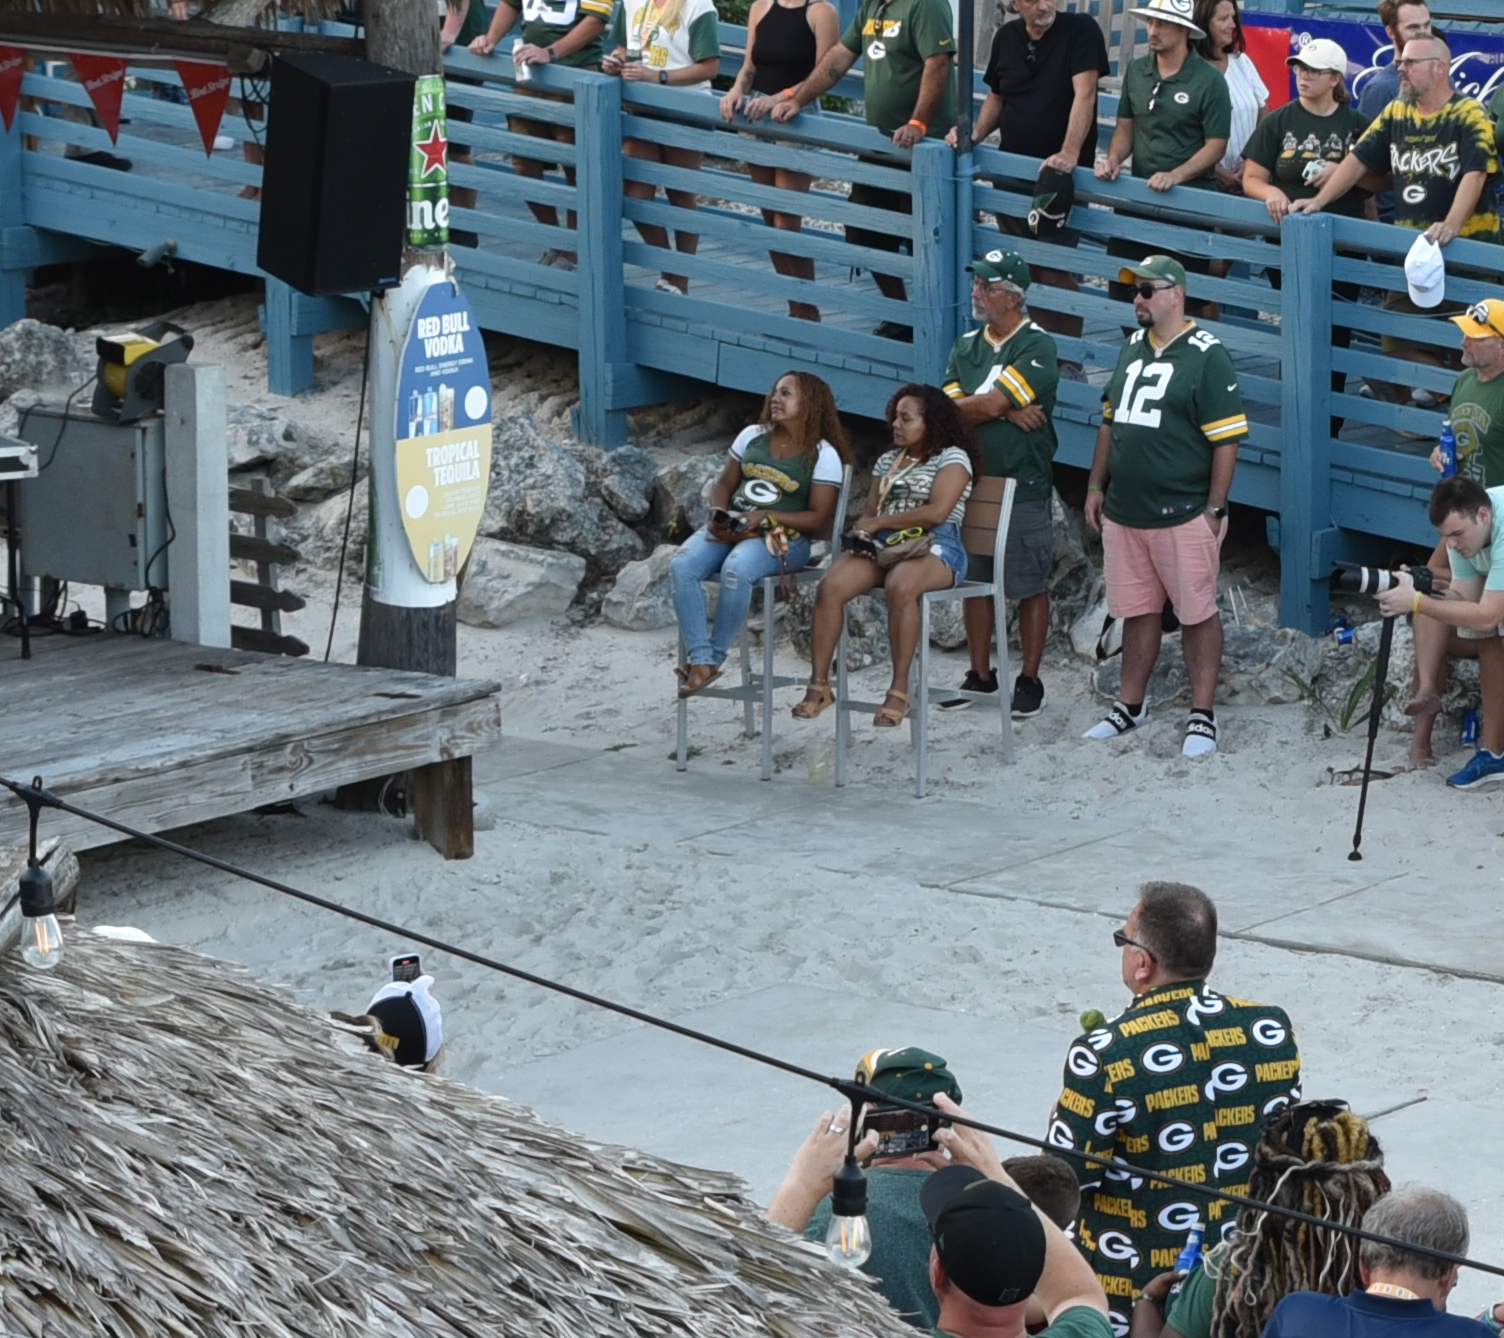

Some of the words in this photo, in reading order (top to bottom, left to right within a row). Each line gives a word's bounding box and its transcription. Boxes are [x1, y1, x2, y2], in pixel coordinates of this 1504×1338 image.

[417, 316, 441, 339] RED
[442, 310, 470, 334] BULL
[423, 333, 464, 359] VODKA
[1113, 359, 1174, 429] 12
[425, 439, 480, 468] TROPICAL
[433, 457, 480, 487] TEQUILA
[1118, 1008, 1180, 1038] PACKERS
[1144, 1084, 1200, 1113] PACKERS
